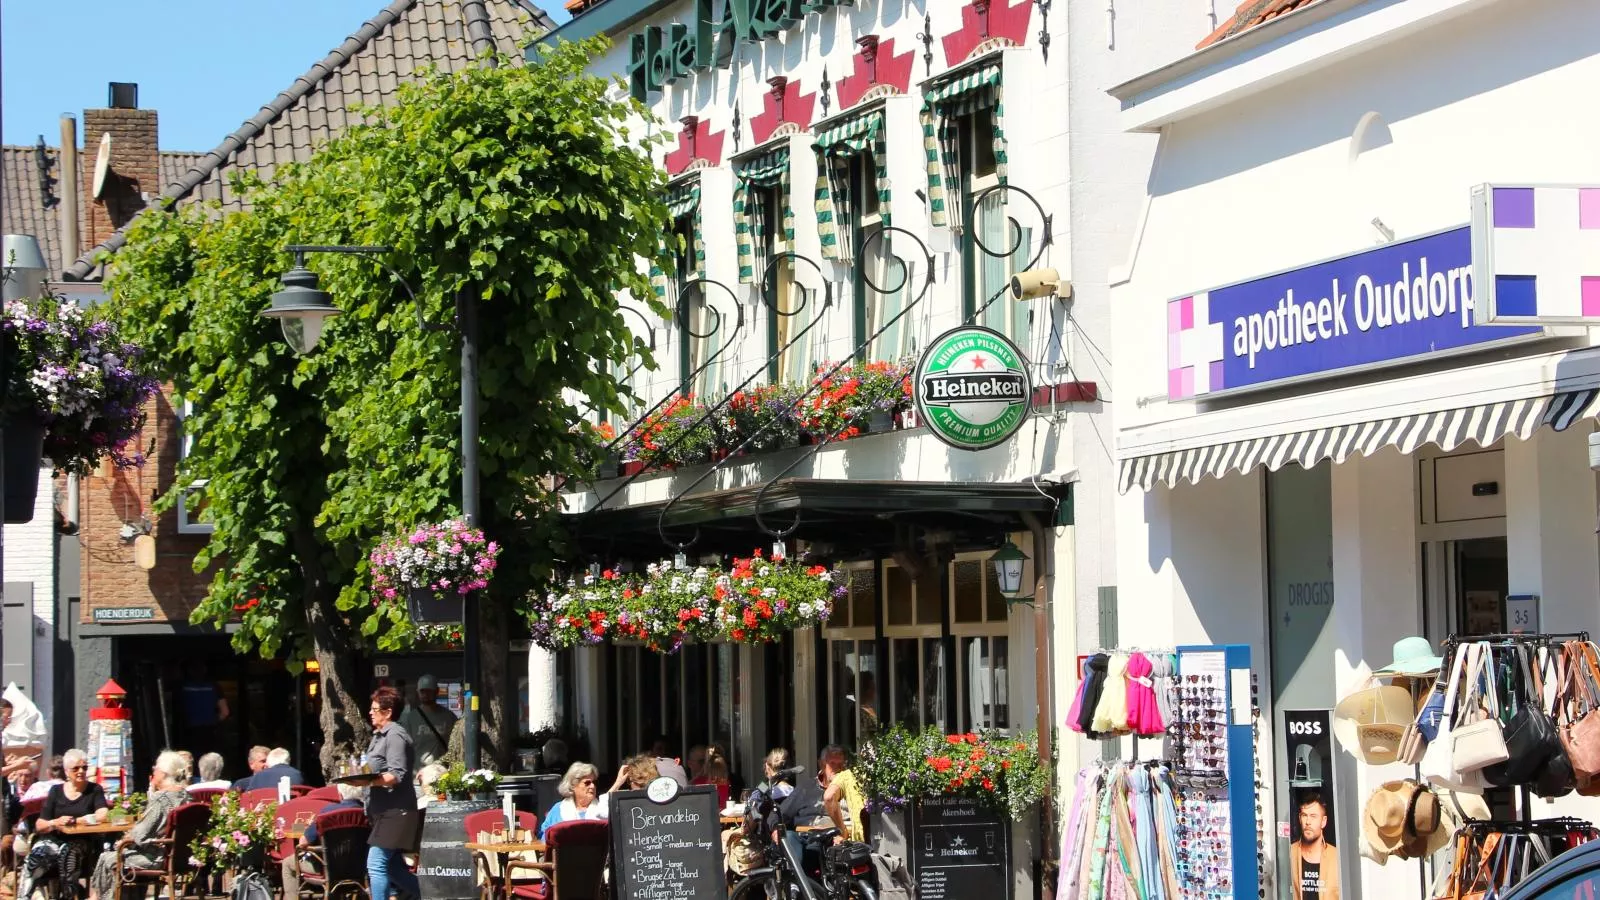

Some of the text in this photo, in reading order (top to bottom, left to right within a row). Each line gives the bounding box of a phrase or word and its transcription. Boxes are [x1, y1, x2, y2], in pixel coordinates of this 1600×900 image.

[627, 0, 714, 103] Hotel
[1233, 256, 1475, 369] apotheek Ouddorp
[936, 338, 1012, 366] HEINEKEN PILSENER
[931, 377, 1022, 398] Heineken
[939, 411, 980, 437] PREMIUM
[983, 409, 1017, 436] QUALITY
[1514, 609, 1529, 624] 3-5
[375, 665, 387, 676] 19
[1289, 721, 1322, 735] BOSS
[631, 806, 656, 829] Bier
[633, 830, 674, 846] Heineken
[635, 851, 660, 866] Brand
[940, 847, 977, 856] Heineken
